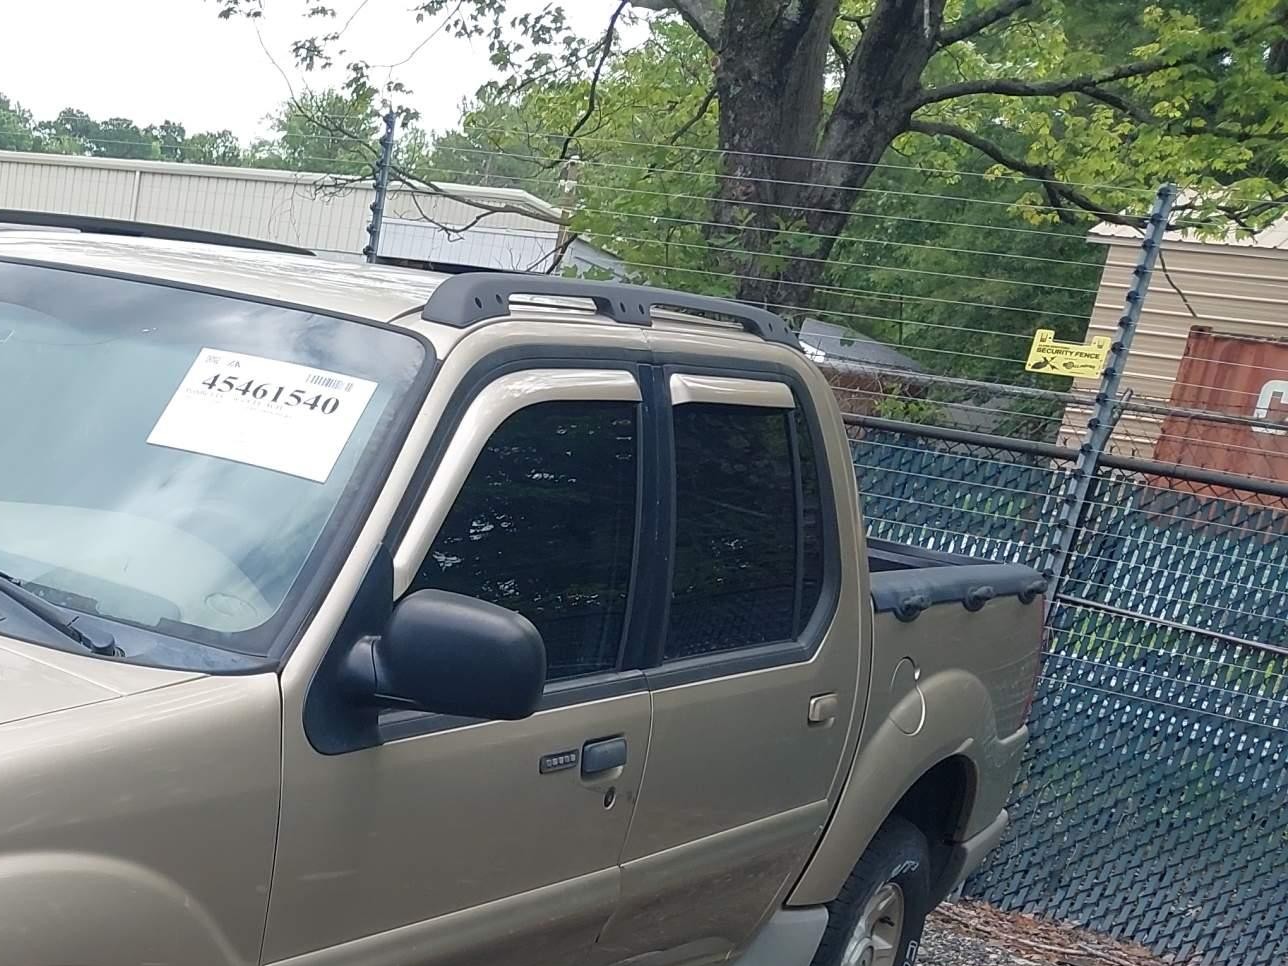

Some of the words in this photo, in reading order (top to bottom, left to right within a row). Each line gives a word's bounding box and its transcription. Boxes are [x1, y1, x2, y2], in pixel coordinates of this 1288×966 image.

[1036, 346, 1074, 357] SECURITY
[1074, 351, 1101, 360] FENCE
[202, 374, 340, 415] 45461540
